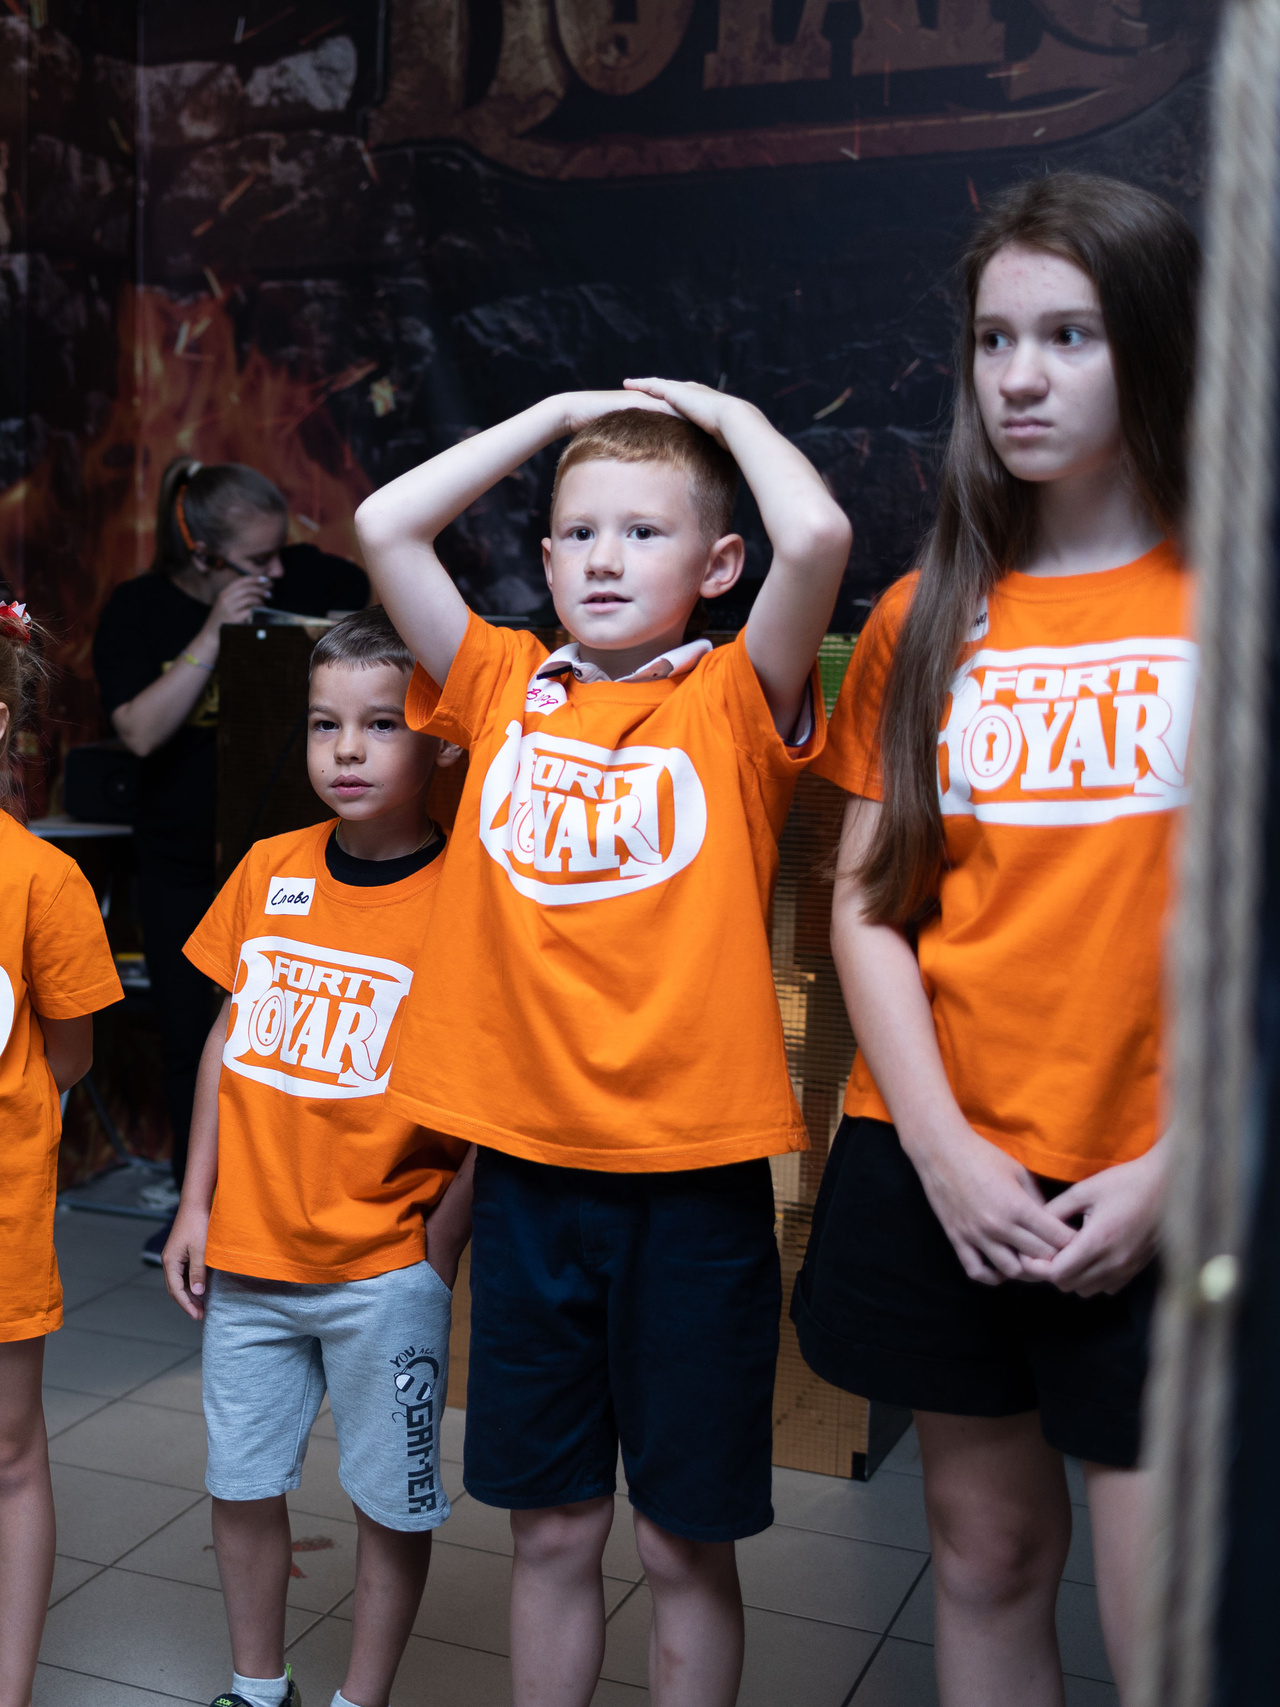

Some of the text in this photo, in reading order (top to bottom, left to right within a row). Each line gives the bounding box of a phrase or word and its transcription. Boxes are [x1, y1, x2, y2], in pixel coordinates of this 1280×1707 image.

[981, 660, 1149, 700] FORT
[272, 955, 373, 999] FORT
[389, 1346, 415, 1368] YOU
[406, 1399, 437, 1514] GAMER
